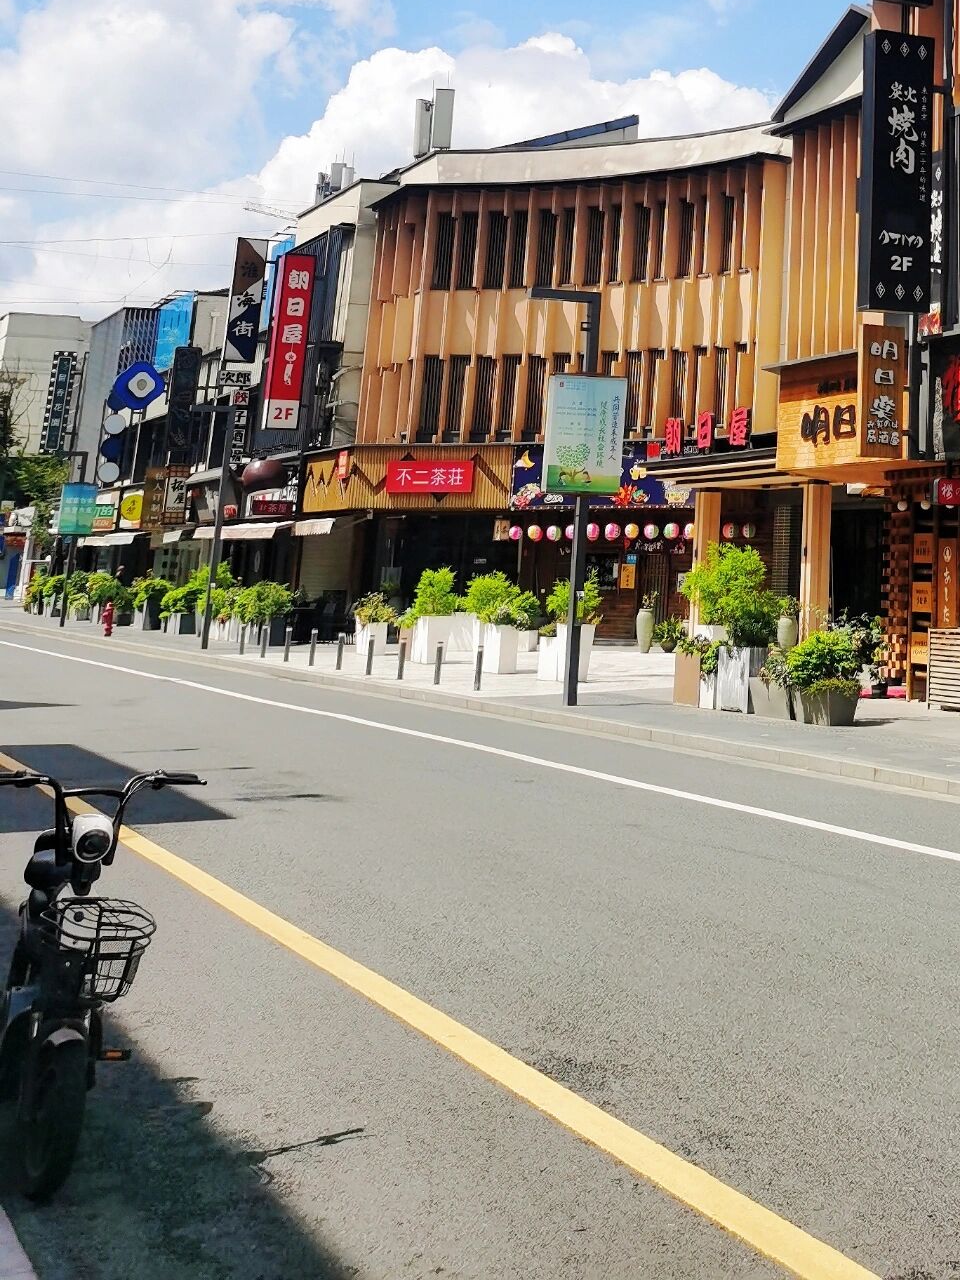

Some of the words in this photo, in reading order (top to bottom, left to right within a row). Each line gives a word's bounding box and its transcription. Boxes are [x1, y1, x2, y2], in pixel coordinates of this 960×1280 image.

[888, 81, 917, 103] 炭火
[890, 255, 913, 272] 2F
[281, 269, 310, 345] 朝日屋
[220, 372, 250, 385] 次郎
[273, 407, 294, 421] 2F
[665, 406, 748, 455] 朝日屋
[801, 404, 857, 448] 明日
